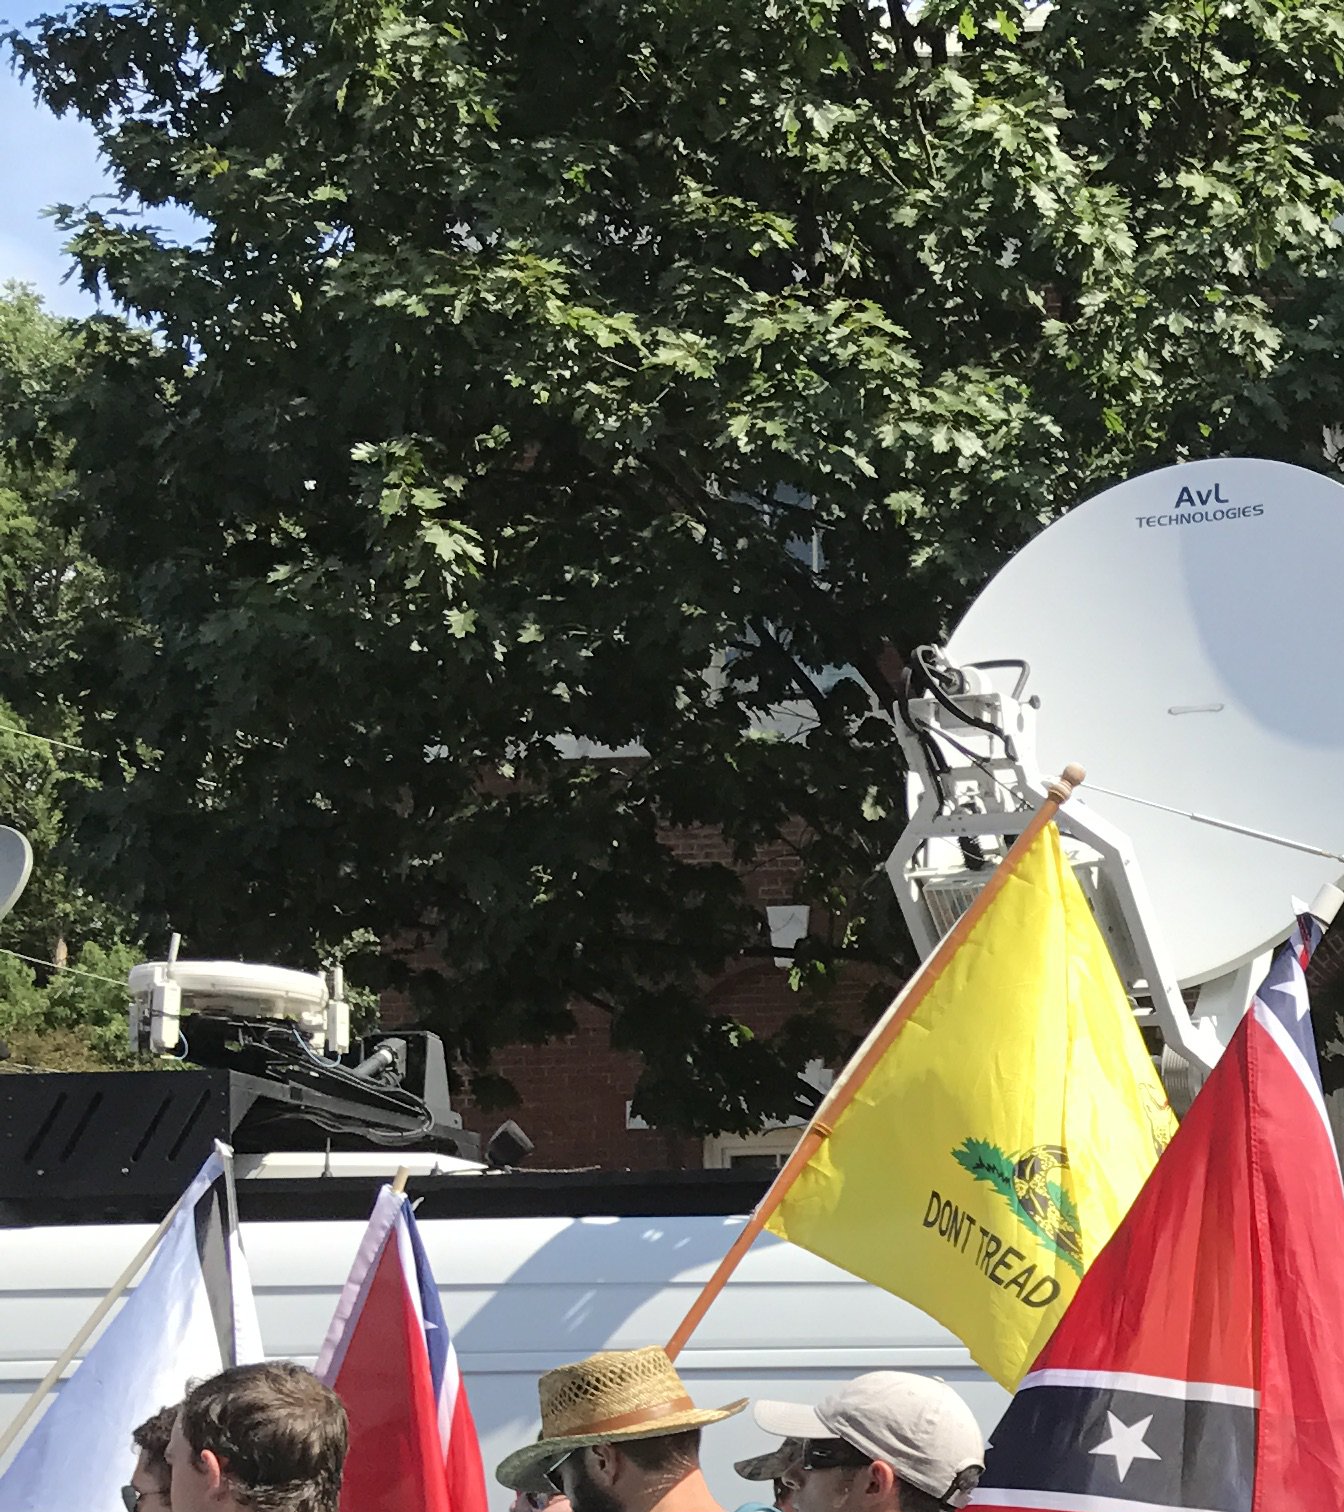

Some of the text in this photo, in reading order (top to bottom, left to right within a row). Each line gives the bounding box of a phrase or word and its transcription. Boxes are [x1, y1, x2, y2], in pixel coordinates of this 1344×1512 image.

[1174, 483, 1230, 509] AvL
[1135, 504, 1264, 529] TECHNOLOGIES
[975, 1227, 1061, 1308] TREAD
